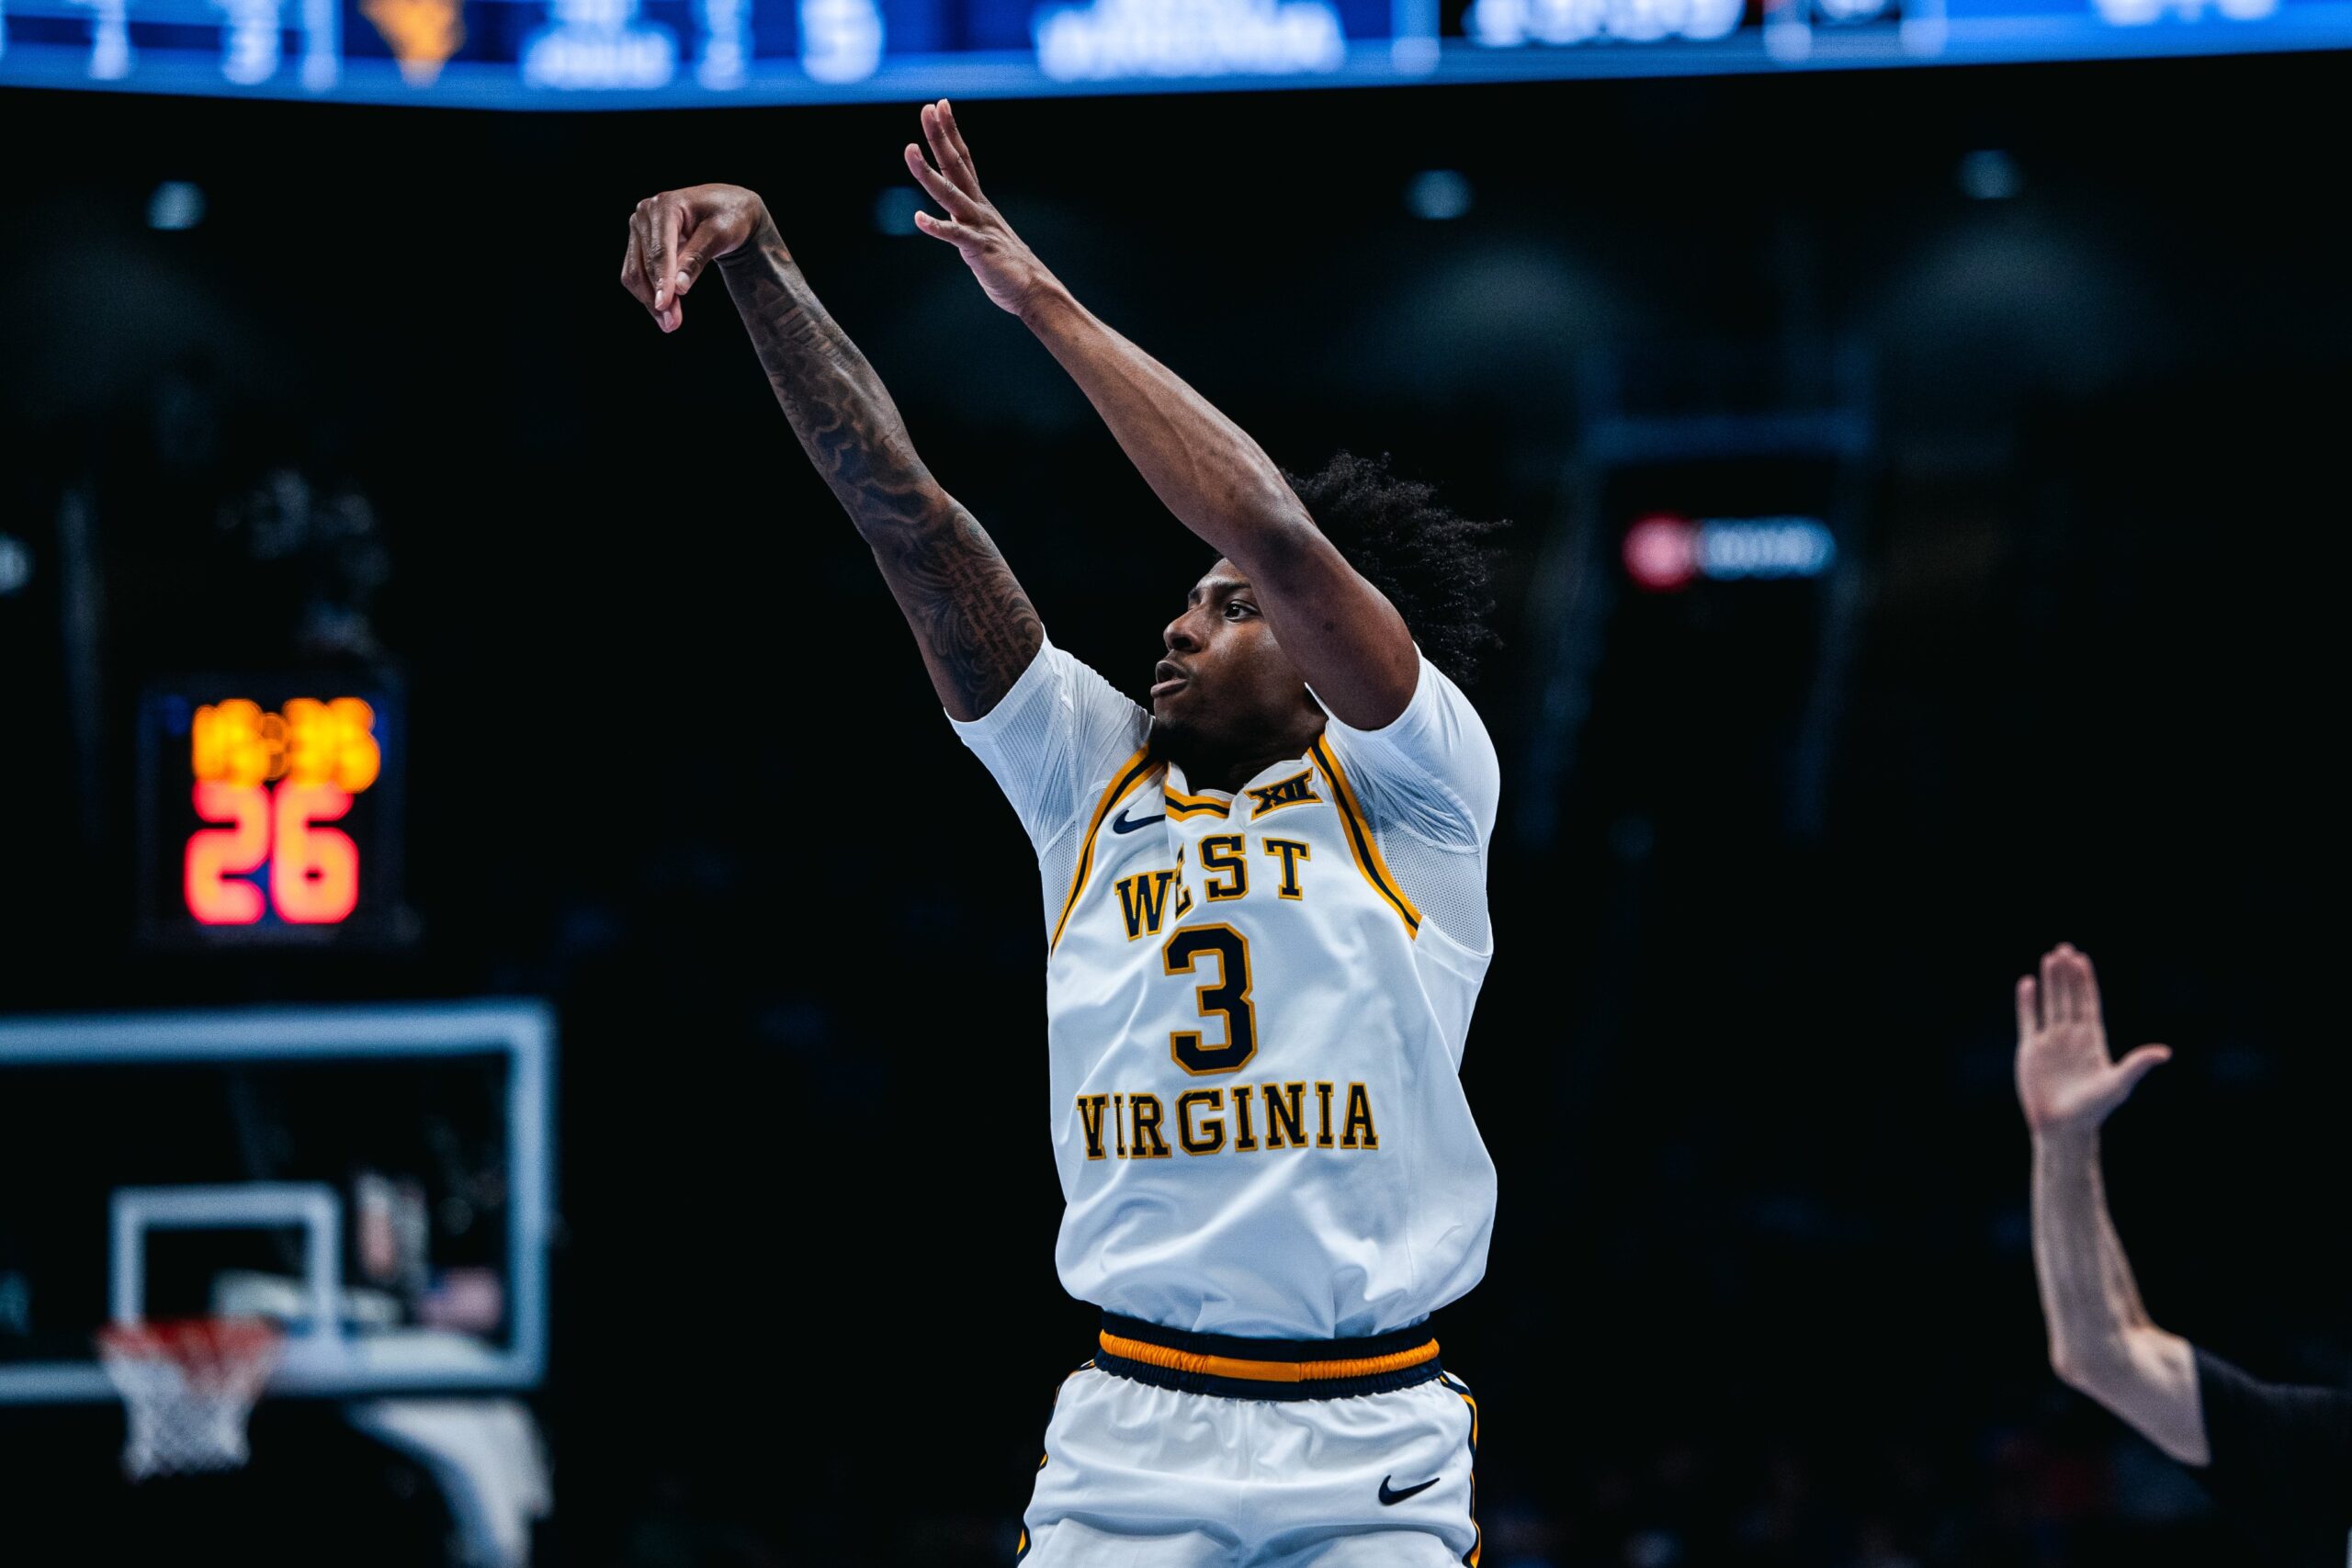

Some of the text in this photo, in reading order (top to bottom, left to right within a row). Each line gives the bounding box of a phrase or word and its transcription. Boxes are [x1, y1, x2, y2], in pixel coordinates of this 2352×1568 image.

[1243, 767, 1323, 820] XII
[184, 780, 359, 925] 26
[1161, 922, 1258, 1076] 3
[1077, 1081, 1379, 1160] VIRGINIA
